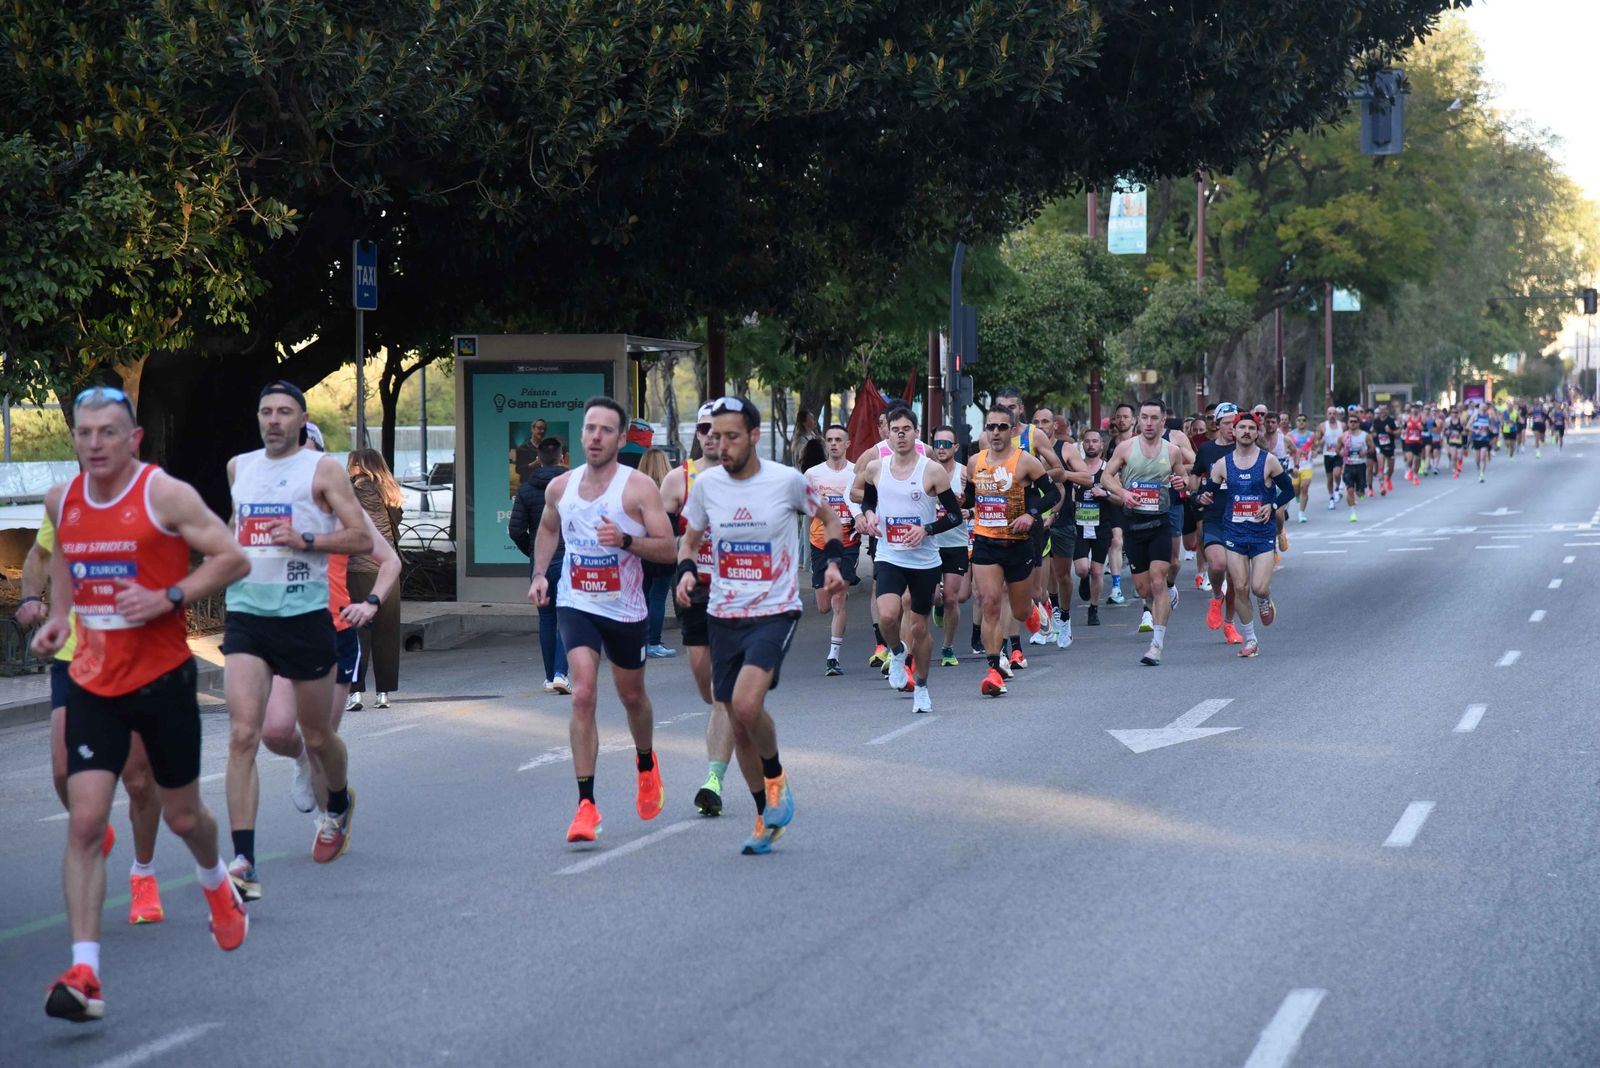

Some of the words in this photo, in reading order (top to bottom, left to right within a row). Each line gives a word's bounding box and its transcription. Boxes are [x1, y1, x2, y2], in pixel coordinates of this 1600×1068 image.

[357, 265, 376, 286] TAXI
[507, 399, 538, 409] Gana
[253, 505, 286, 514] ZURICH
[62, 543, 87, 554] SELBY
[88, 541, 137, 553] STRIDERS
[734, 544, 765, 552] ZURICH
[583, 557, 613, 566] ZURICH
[89, 565, 129, 576] ZURICH
[727, 567, 763, 580] SERGIO
[580, 580, 608, 592] TOMZ
